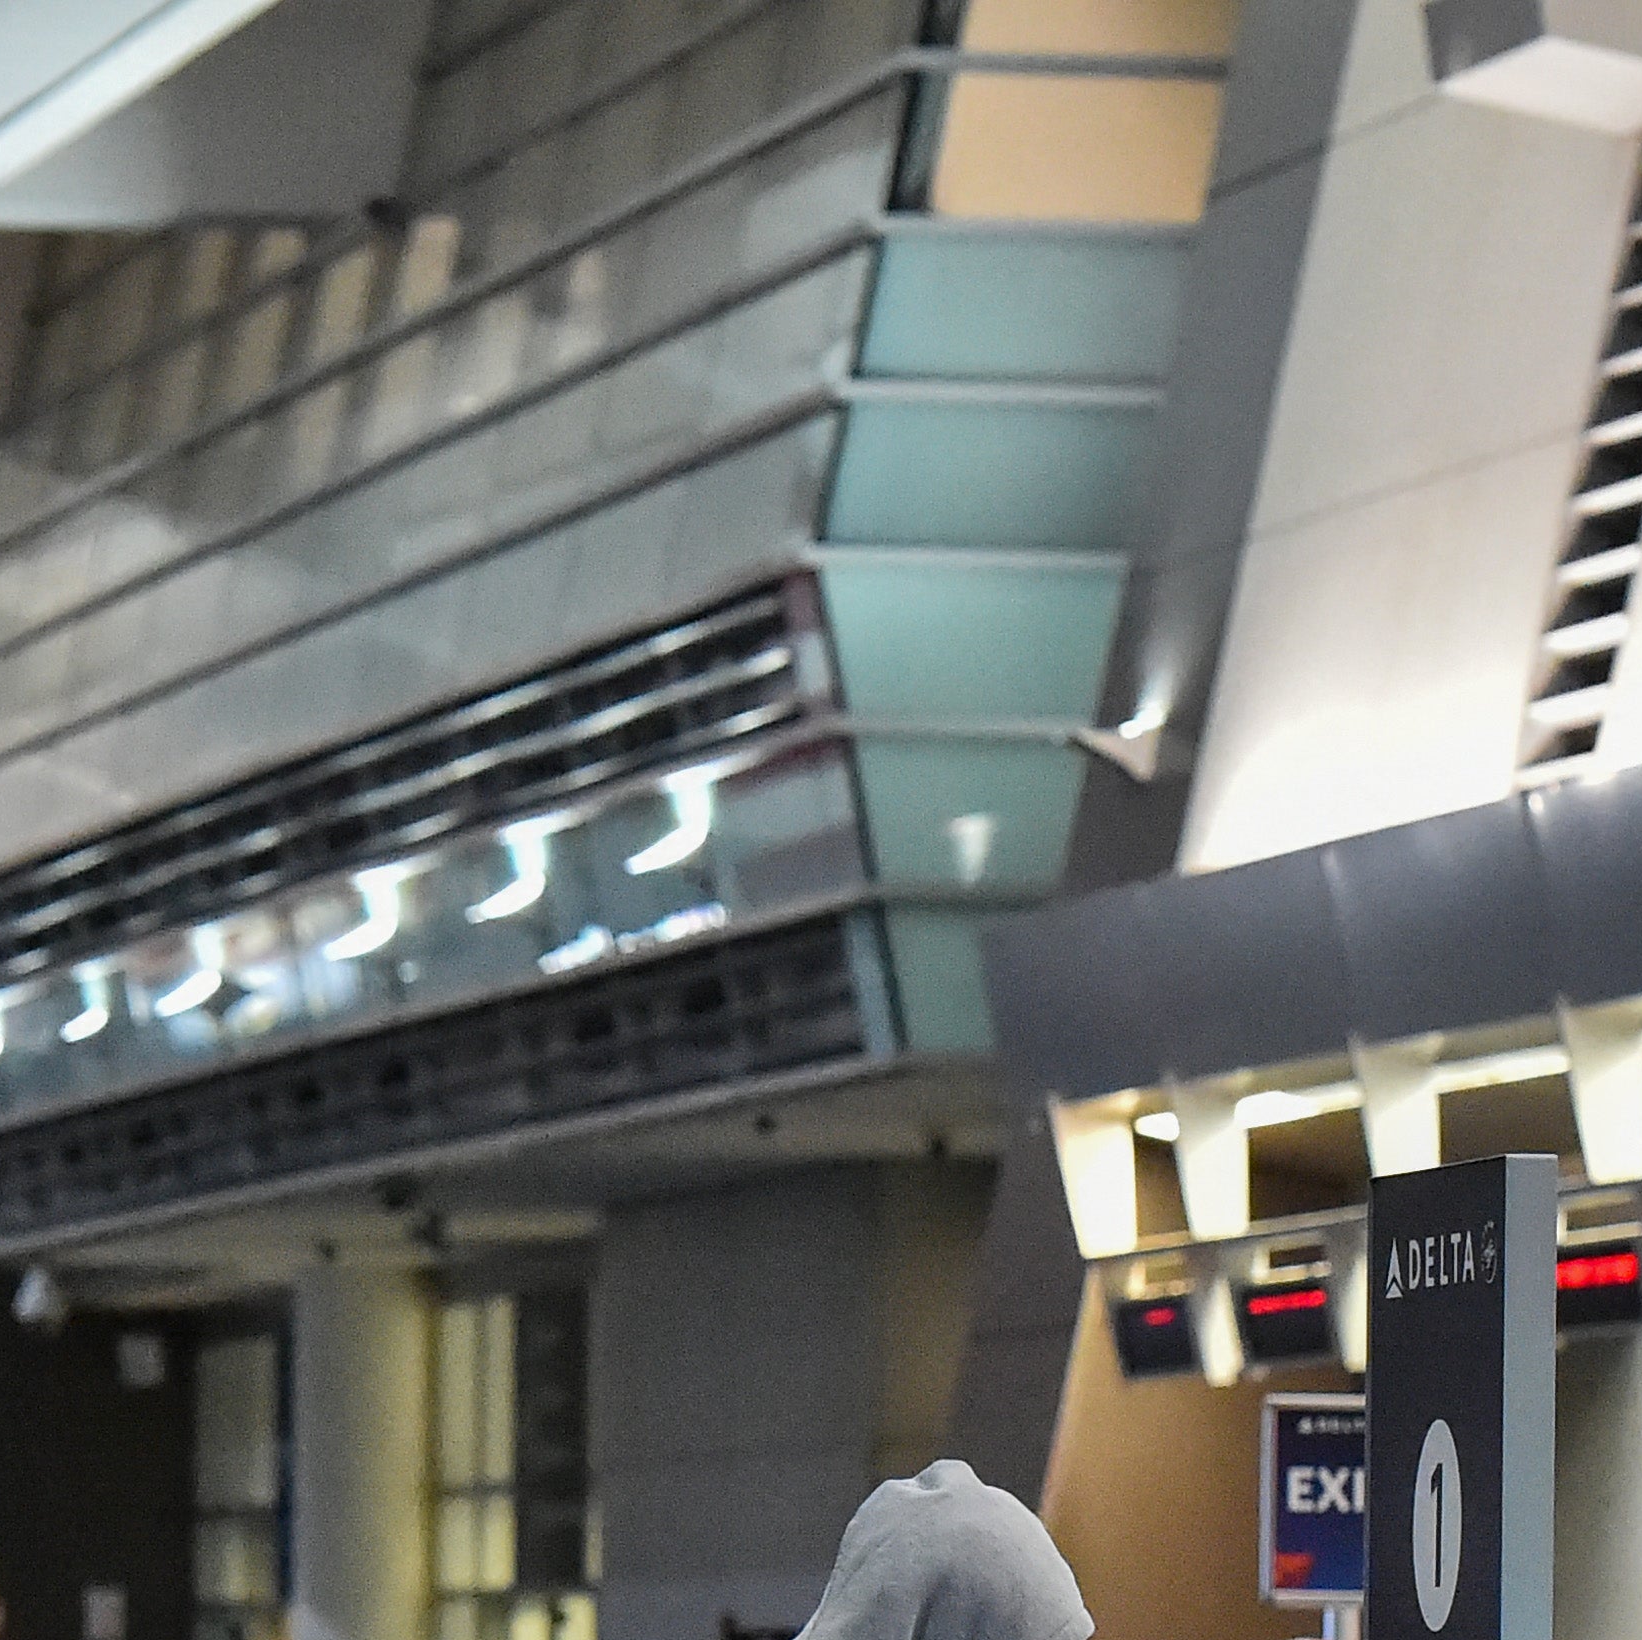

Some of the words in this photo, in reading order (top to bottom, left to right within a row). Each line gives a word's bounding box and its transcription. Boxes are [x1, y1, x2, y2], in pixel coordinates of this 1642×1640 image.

[1408, 1230, 1476, 1290] DELTA
[1286, 1464, 1366, 1514] EXI
[1431, 1463, 1443, 1588] 1
